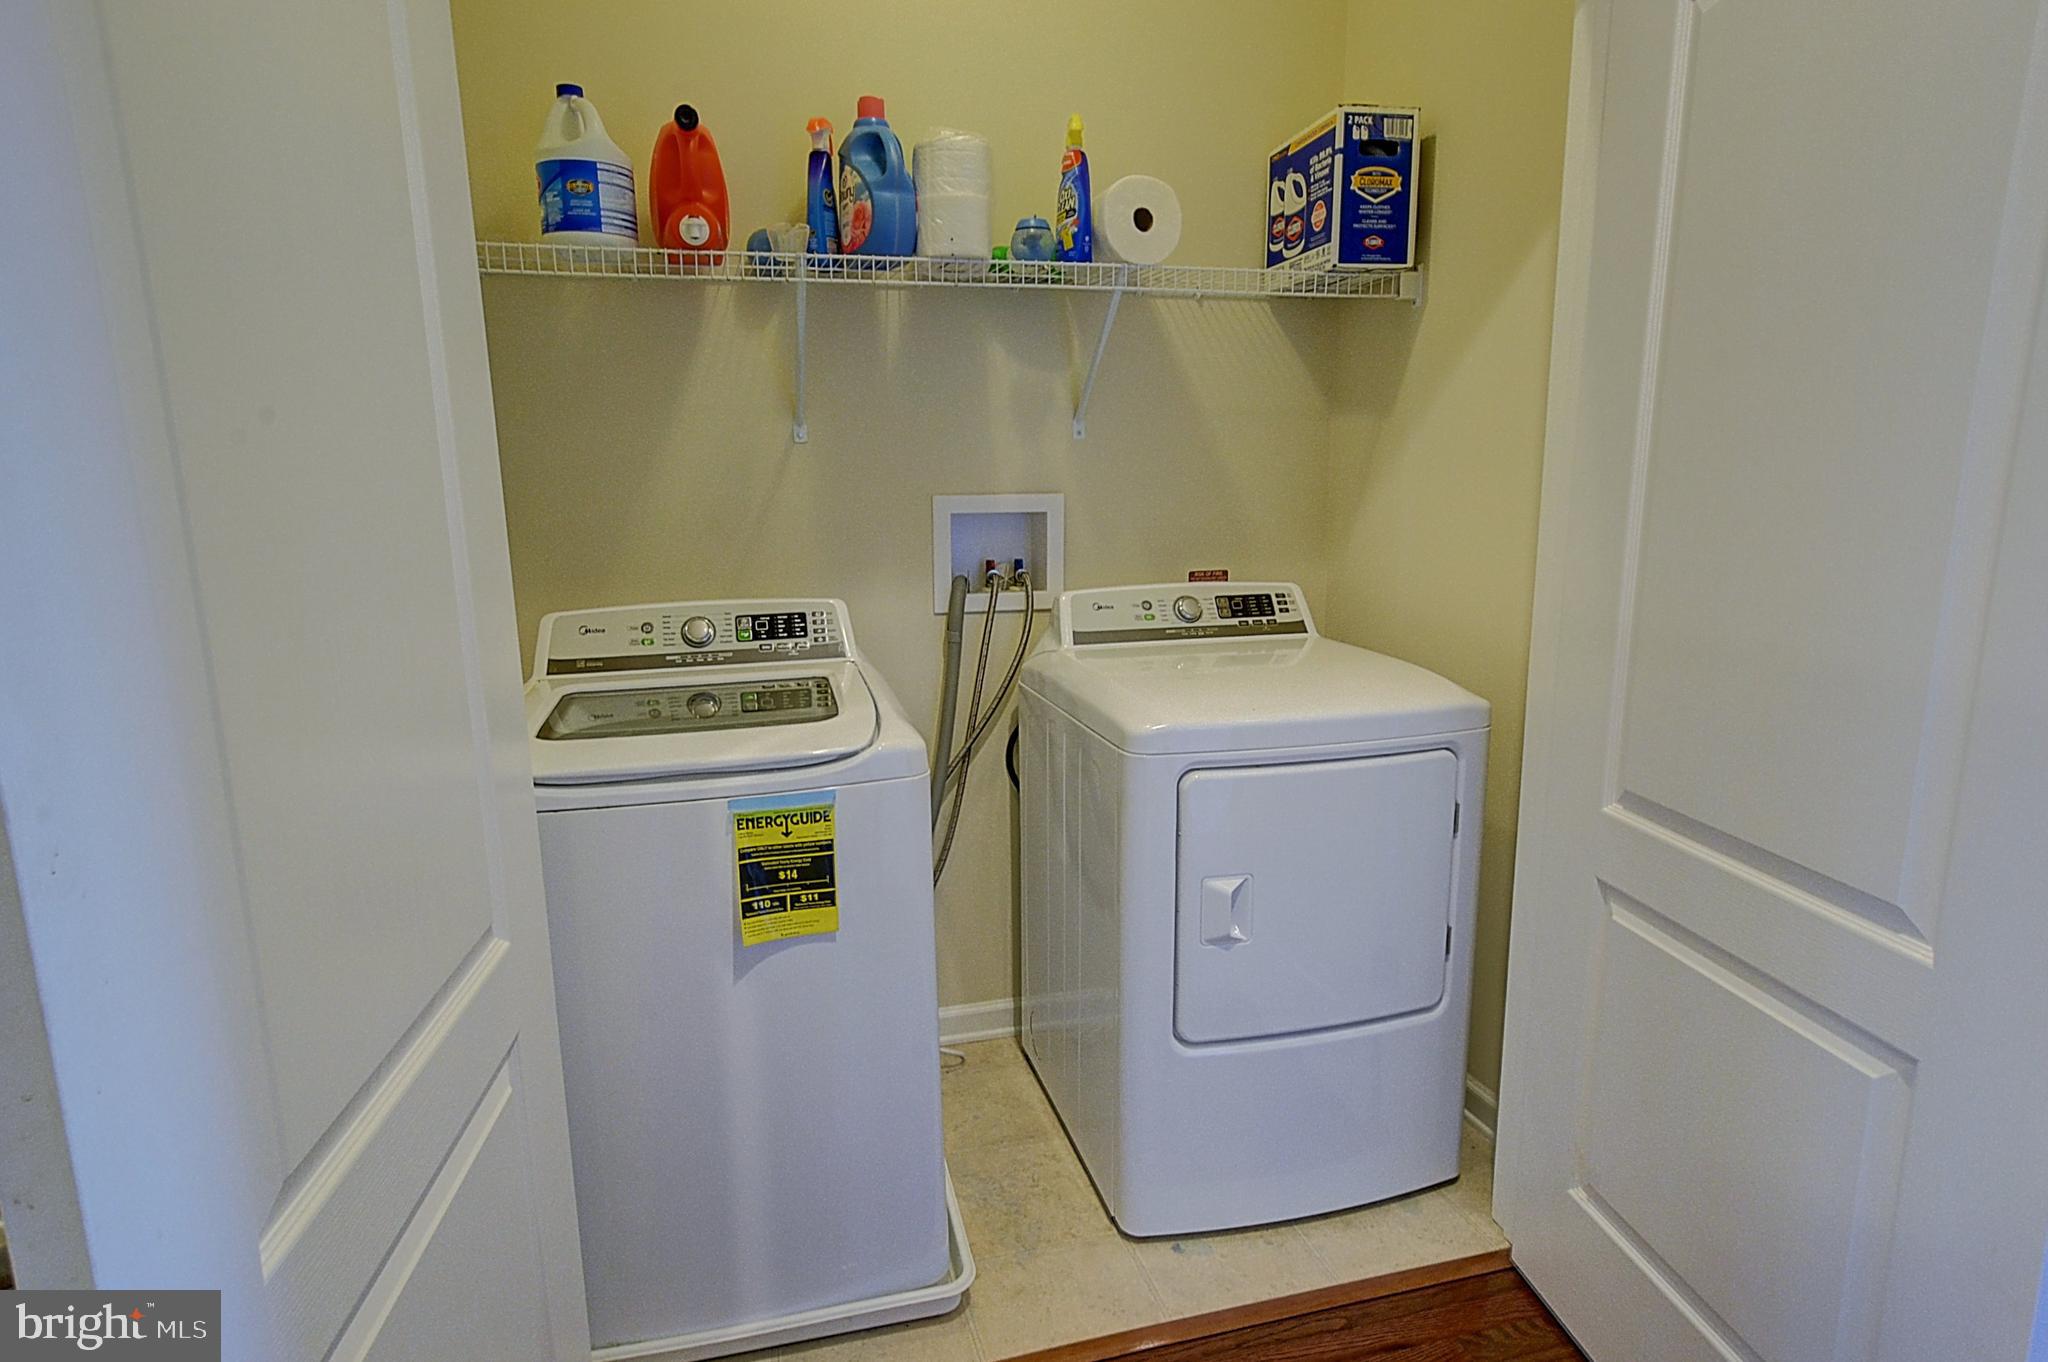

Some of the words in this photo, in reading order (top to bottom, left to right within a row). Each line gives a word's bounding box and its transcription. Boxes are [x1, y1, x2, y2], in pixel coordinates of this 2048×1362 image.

[1348, 115, 1353, 125] 2
[1354, 115, 1374, 126] PACK
[1359, 176, 1393, 186] CLOROMAX
[579, 625, 606, 636] Midea
[736, 810, 832, 831] ENERGYGUIDE
[778, 869, 798, 880] $14
[800, 893, 819, 903] $11
[752, 900, 771, 910] 110
